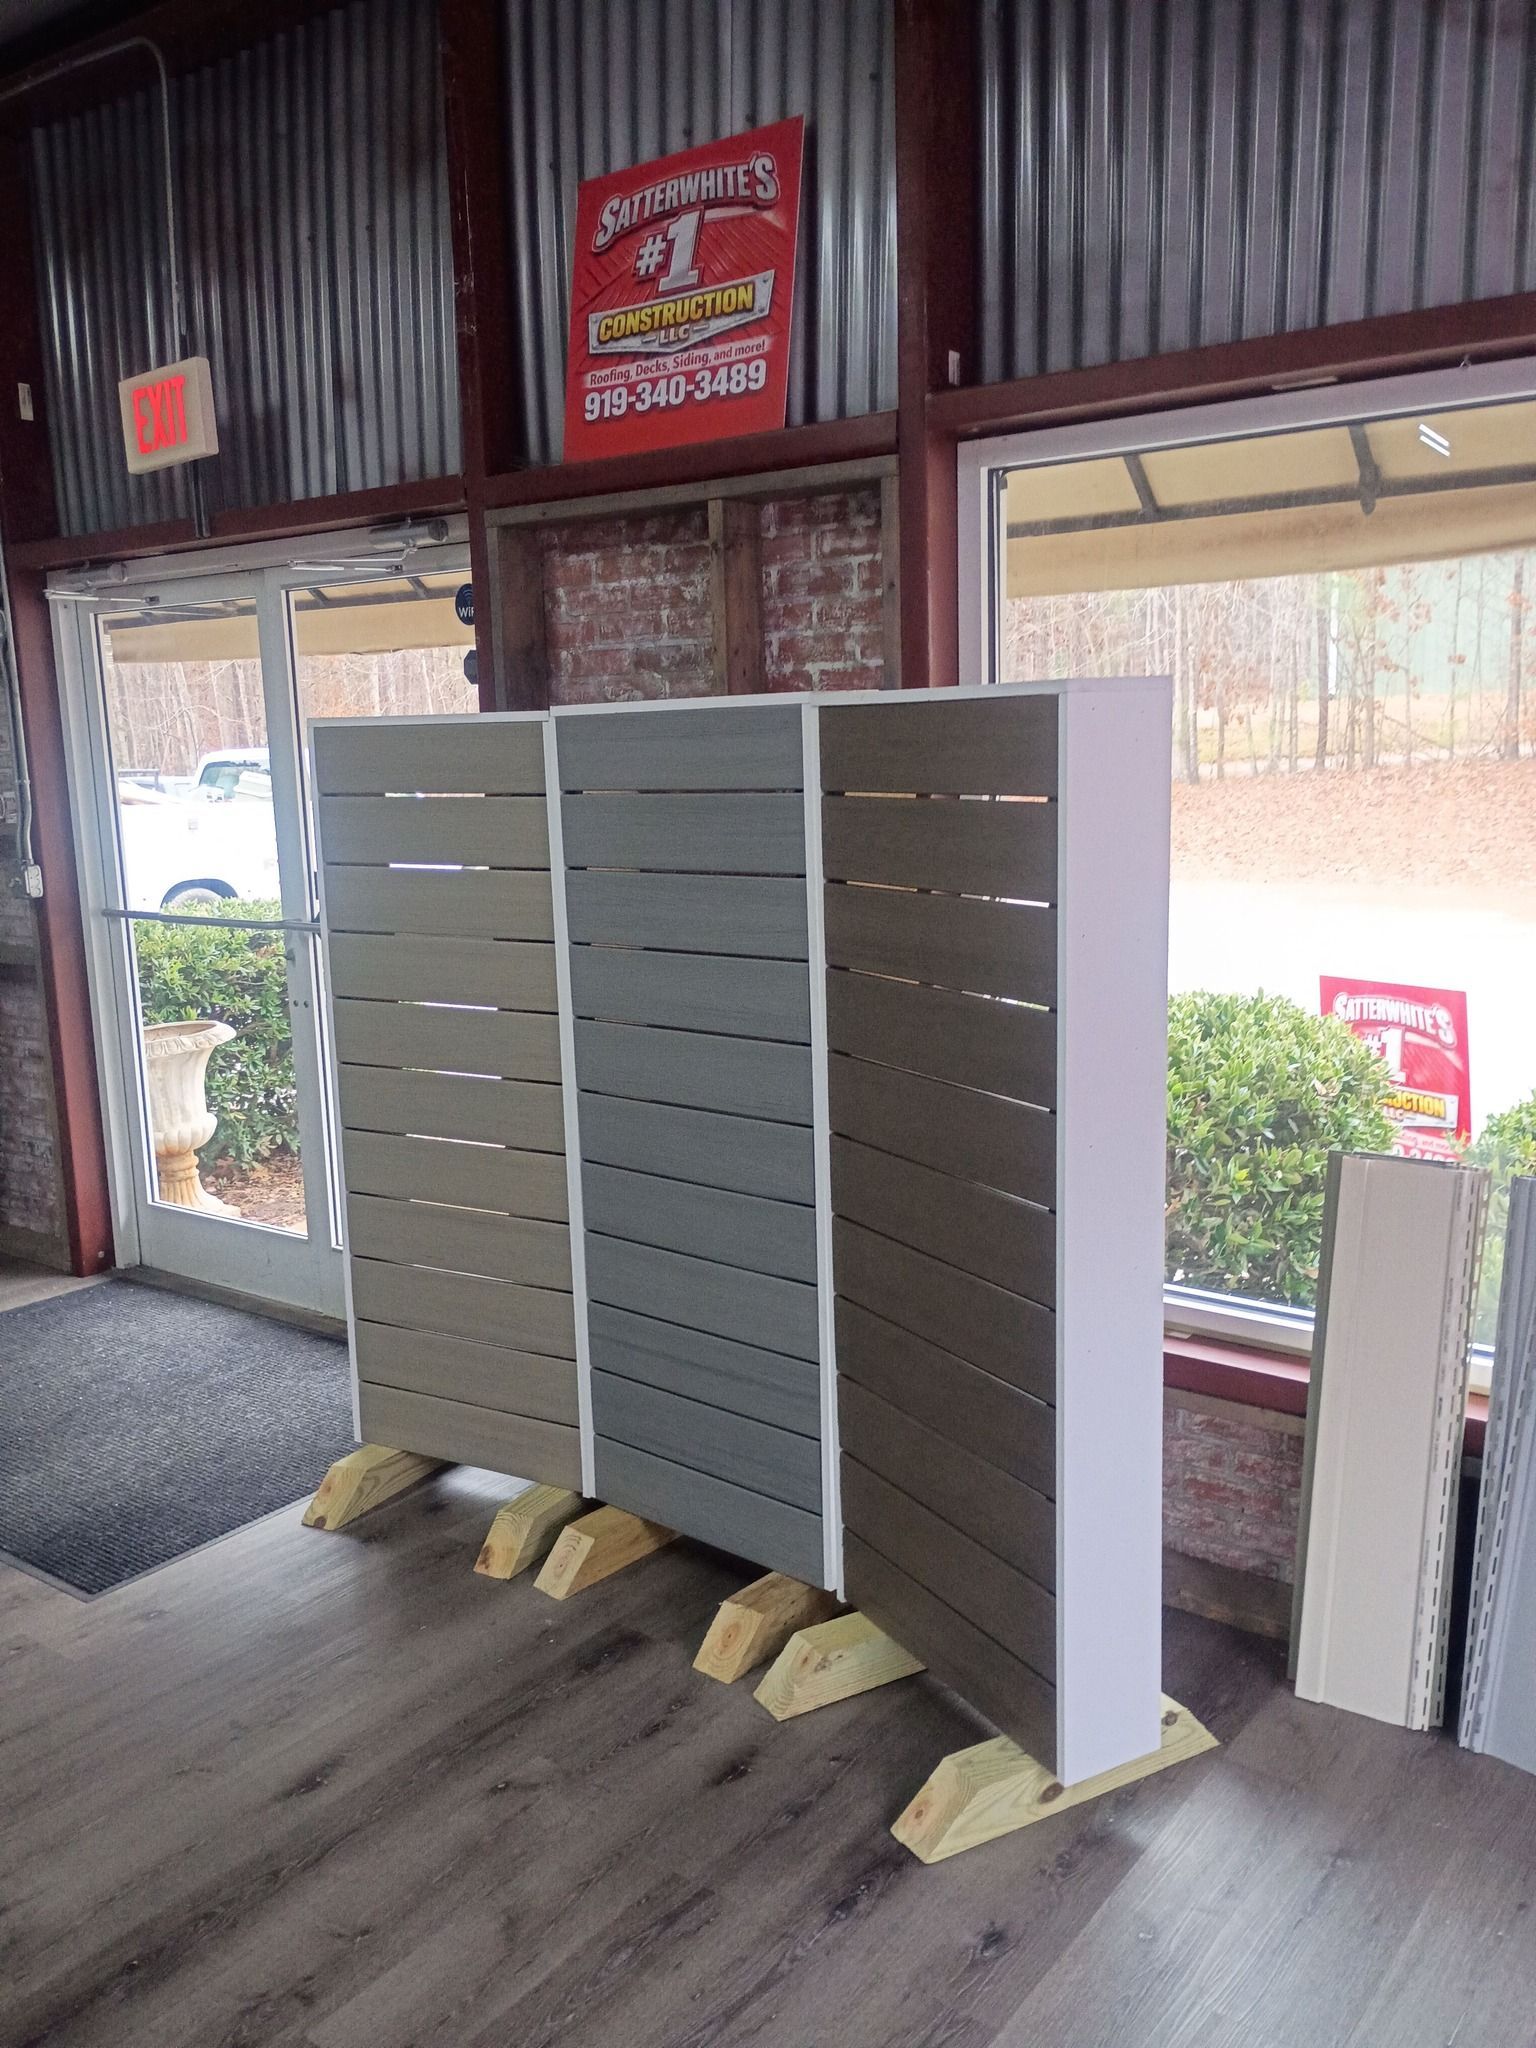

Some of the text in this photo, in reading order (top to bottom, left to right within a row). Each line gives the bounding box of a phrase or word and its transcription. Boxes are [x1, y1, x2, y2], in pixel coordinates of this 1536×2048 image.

[594, 155, 780, 248] SATTERWHITE'S
[635, 210, 701, 292] #1
[598, 284, 754, 342] CONSTRUCTION
[659, 324, 690, 343] LLC
[584, 358, 767, 422] 919-340-3489
[590, 339, 766, 387] Roofing, Decks, Siding, and more!
[132, 374, 188, 455] EXIT
[1334, 993, 1456, 1045] SATTERWHITE'S
